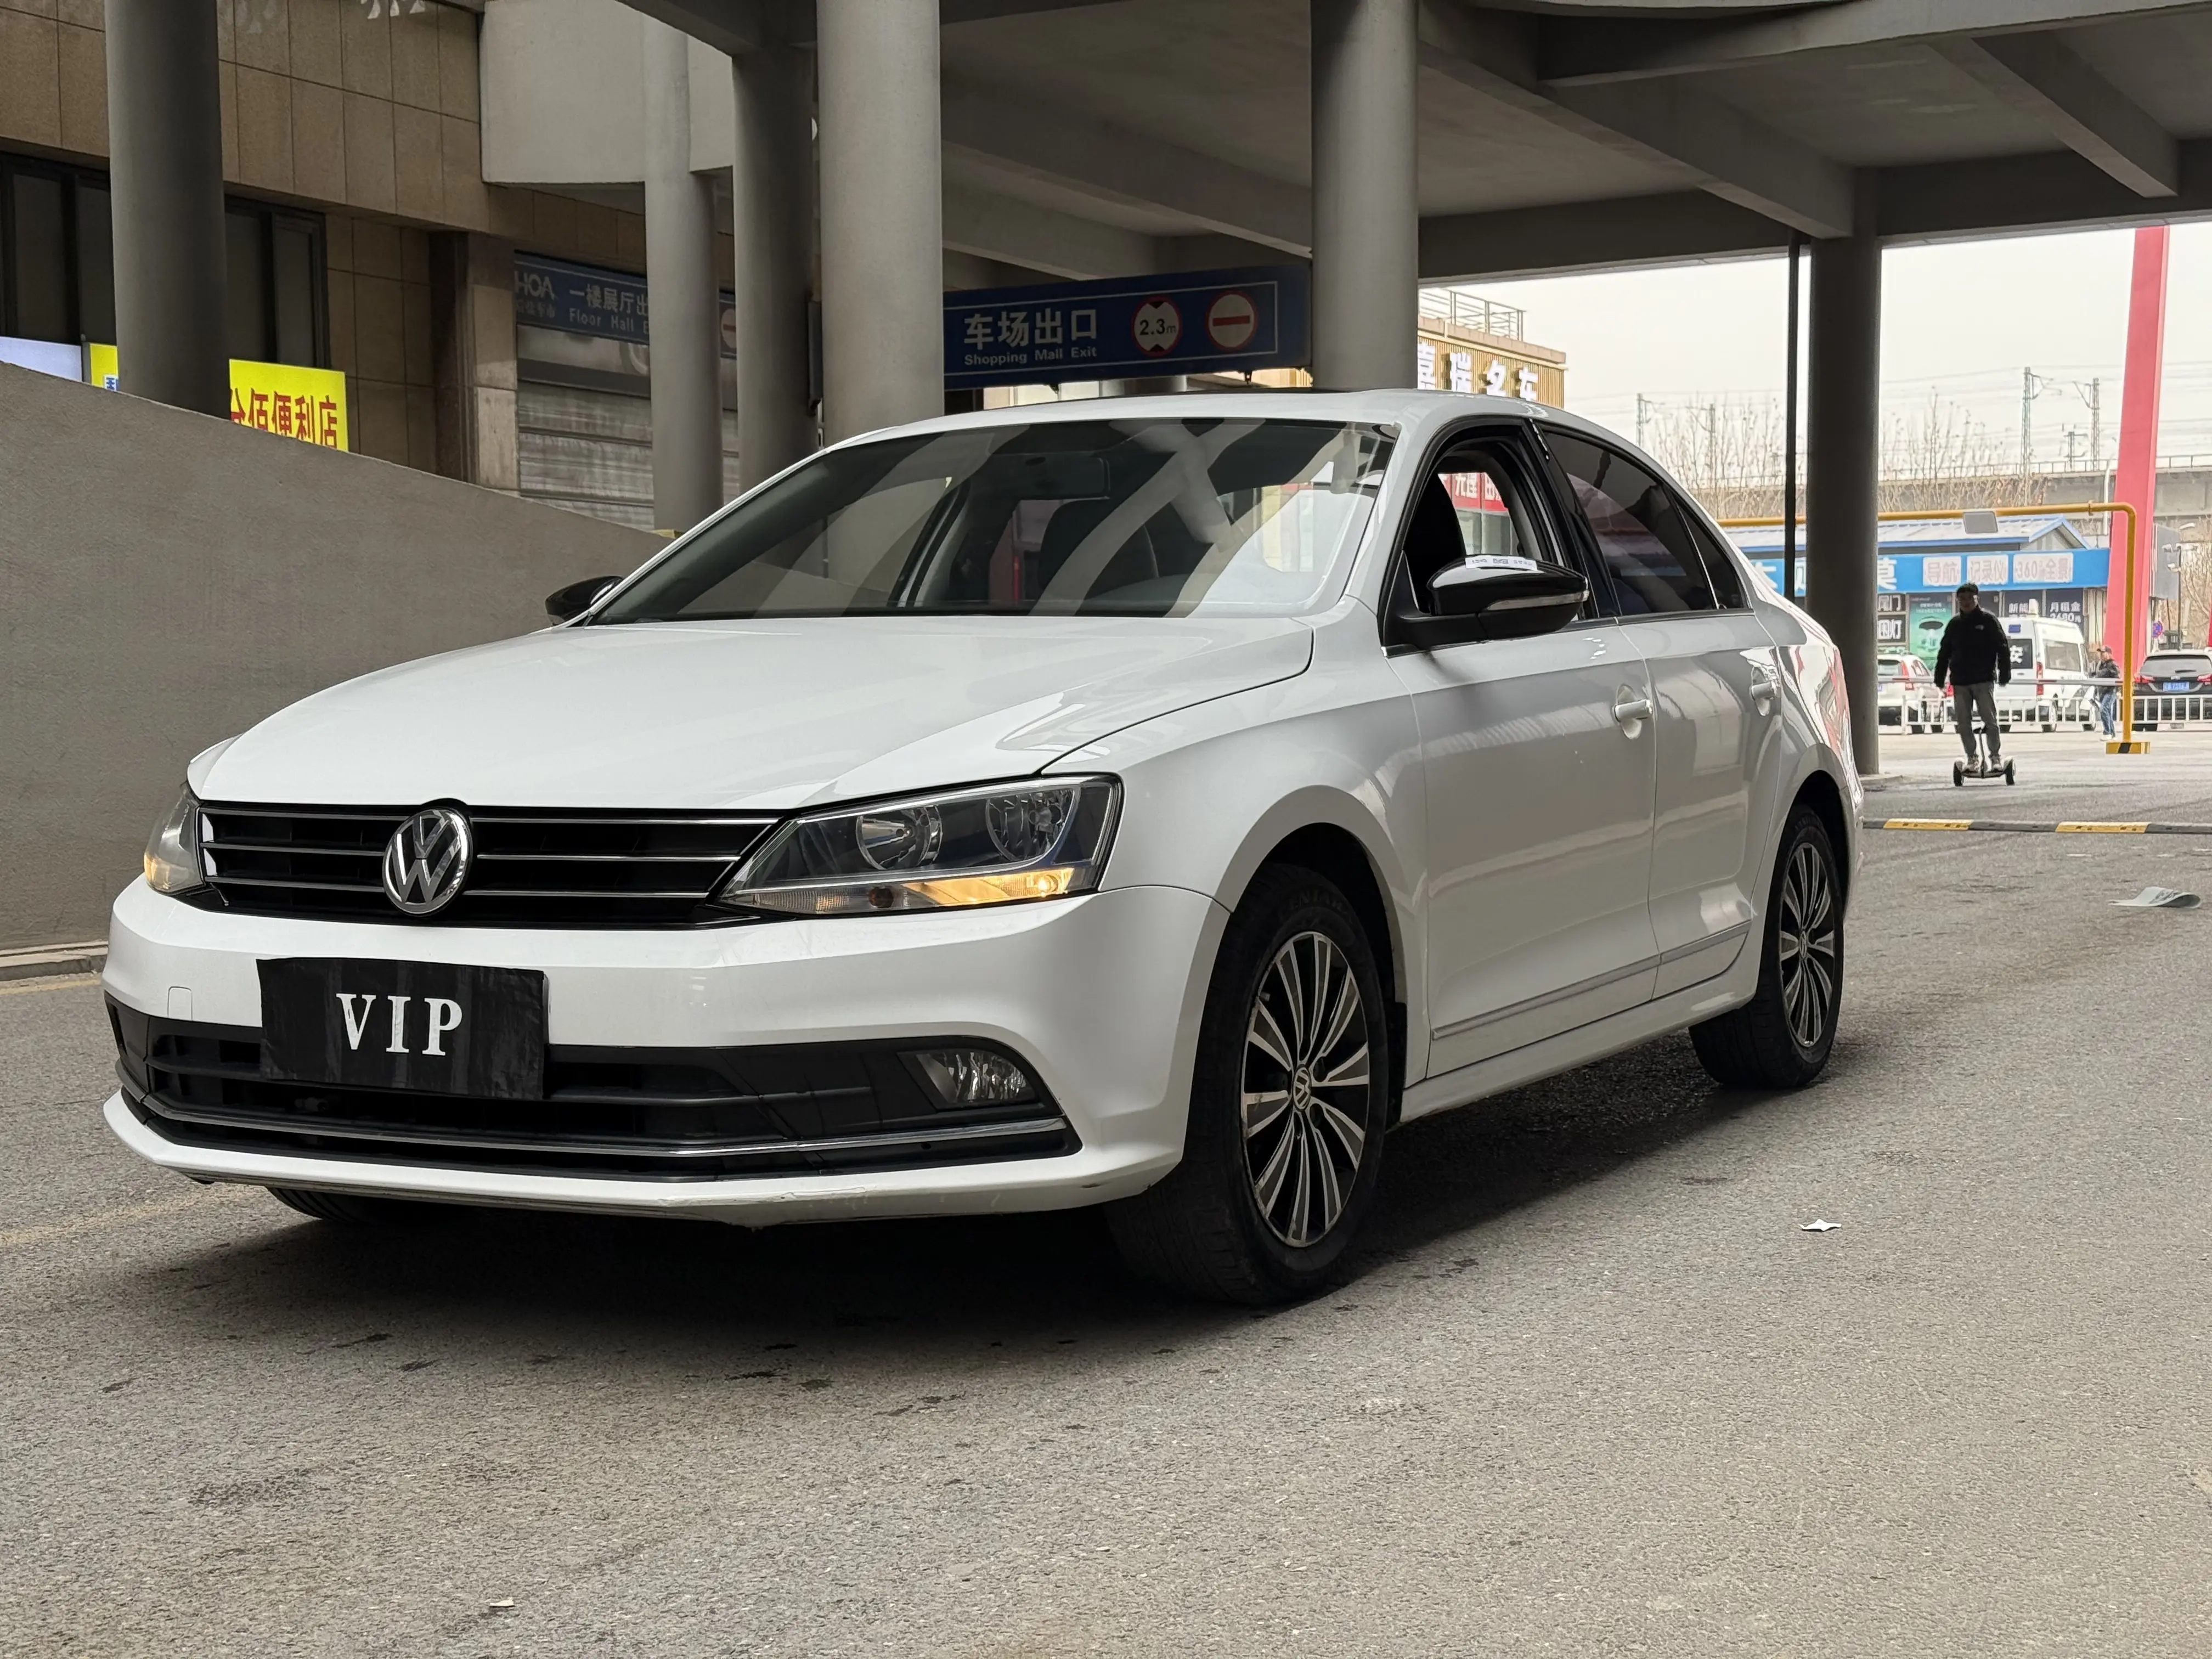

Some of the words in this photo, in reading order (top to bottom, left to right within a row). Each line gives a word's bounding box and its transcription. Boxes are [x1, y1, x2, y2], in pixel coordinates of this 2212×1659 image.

[569, 308, 602, 326] Floor
[611, 315, 634, 332] Hall
[964, 308, 1097, 350] 车场出口
[964, 352, 1027, 366] Shopping
[1035, 348, 1063, 360] Mall
[1071, 346, 1097, 358] Exit
[1927, 561, 1957, 583] 导航
[336, 993, 462, 1056] VIP
